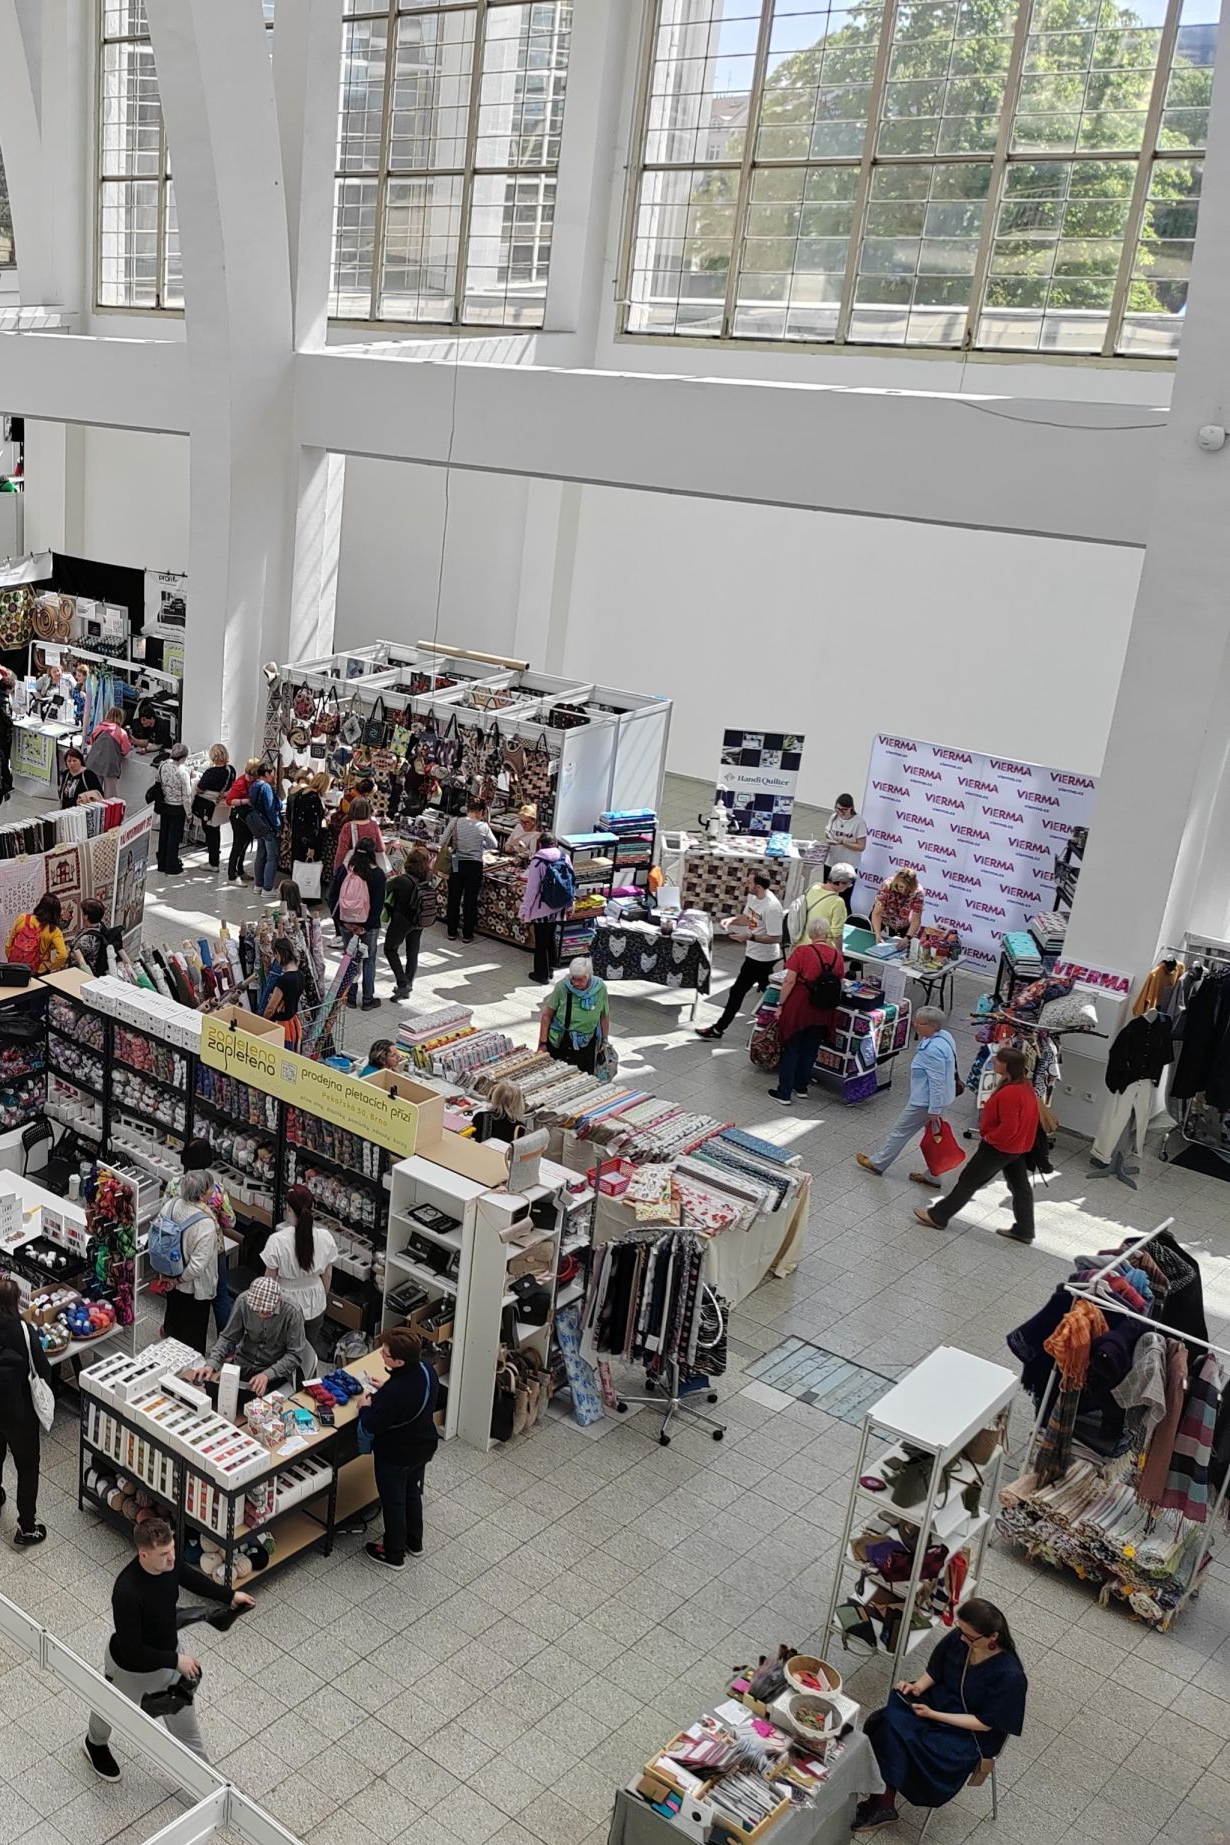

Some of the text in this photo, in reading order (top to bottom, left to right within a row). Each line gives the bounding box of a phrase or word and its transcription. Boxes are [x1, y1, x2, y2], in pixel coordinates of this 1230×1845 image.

[879, 736, 917, 752] VIERMA
[933, 748, 973, 764] VIERMA
[903, 764, 942, 781] VIERMA
[990, 760, 1032, 777] VIERMA
[872, 781, 910, 797] VIERMA
[958, 776, 998, 793] VIERMA
[1051, 772, 1095, 789] VIERMA
[925, 793, 965, 810] VIERMA
[1017, 789, 1060, 807] VIERMA
[896, 810, 934, 827] VIERMA
[982, 806, 1023, 823] VIERMA
[950, 824, 990, 841] VIERMA
[1042, 819, 1075, 835] VIERM
[866, 828, 903, 844] VIERMA
[918, 840, 957, 858] VIERMA
[1008, 837, 1050, 855] VIERMA
[889, 856, 927, 873] VIERMA
[974, 854, 1014, 872] VIERMA
[942, 869, 981, 887] VIERMA
[999, 884, 1041, 902] VIERMA
[965, 899, 1006, 917] VIERMA
[934, 915, 973, 933] VIERMA
[1053, 960, 1130, 993] VIERMA
[207, 1036, 276, 1076] zapleteno
[301, 1068, 343, 1092] prodejna
[345, 1086, 388, 1113] pletacích
[369, 1115, 388, 1127] Brno
